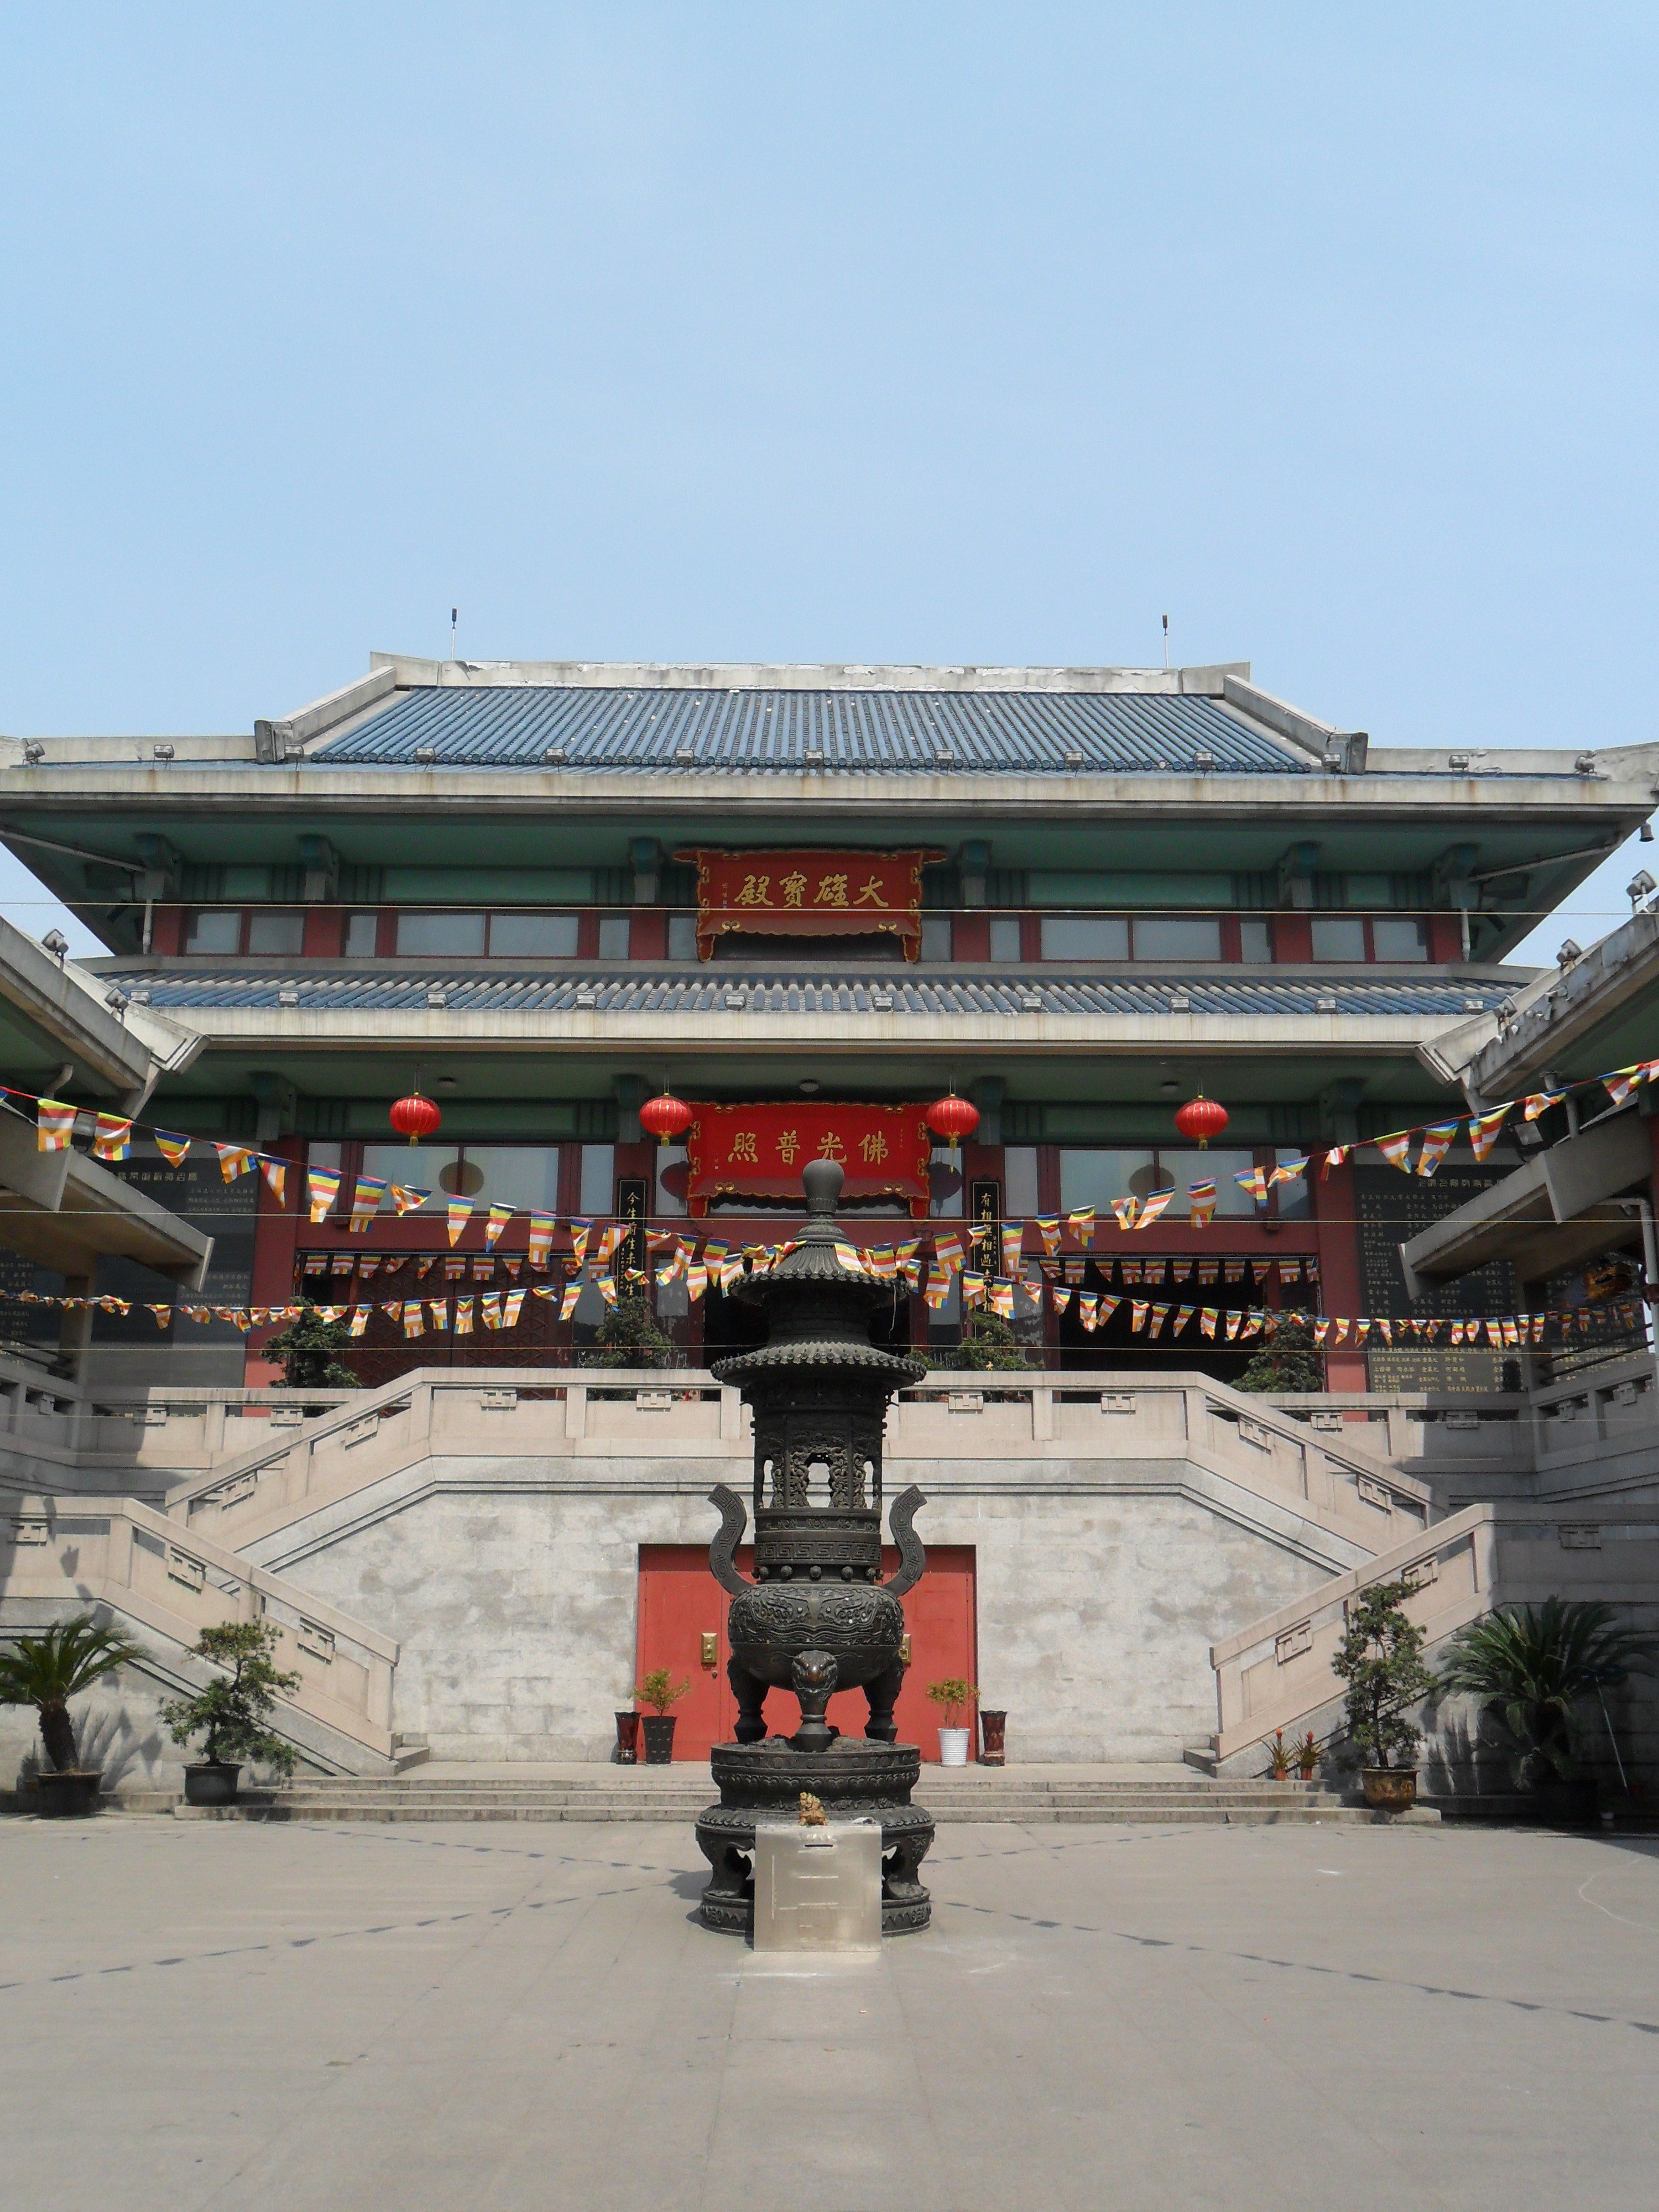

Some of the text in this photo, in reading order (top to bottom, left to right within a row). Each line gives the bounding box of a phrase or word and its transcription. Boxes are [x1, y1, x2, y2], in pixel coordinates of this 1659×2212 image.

[727, 1129, 889, 1165] 佛光普照
[625, 1192, 640, 1296] 今生前生未生
